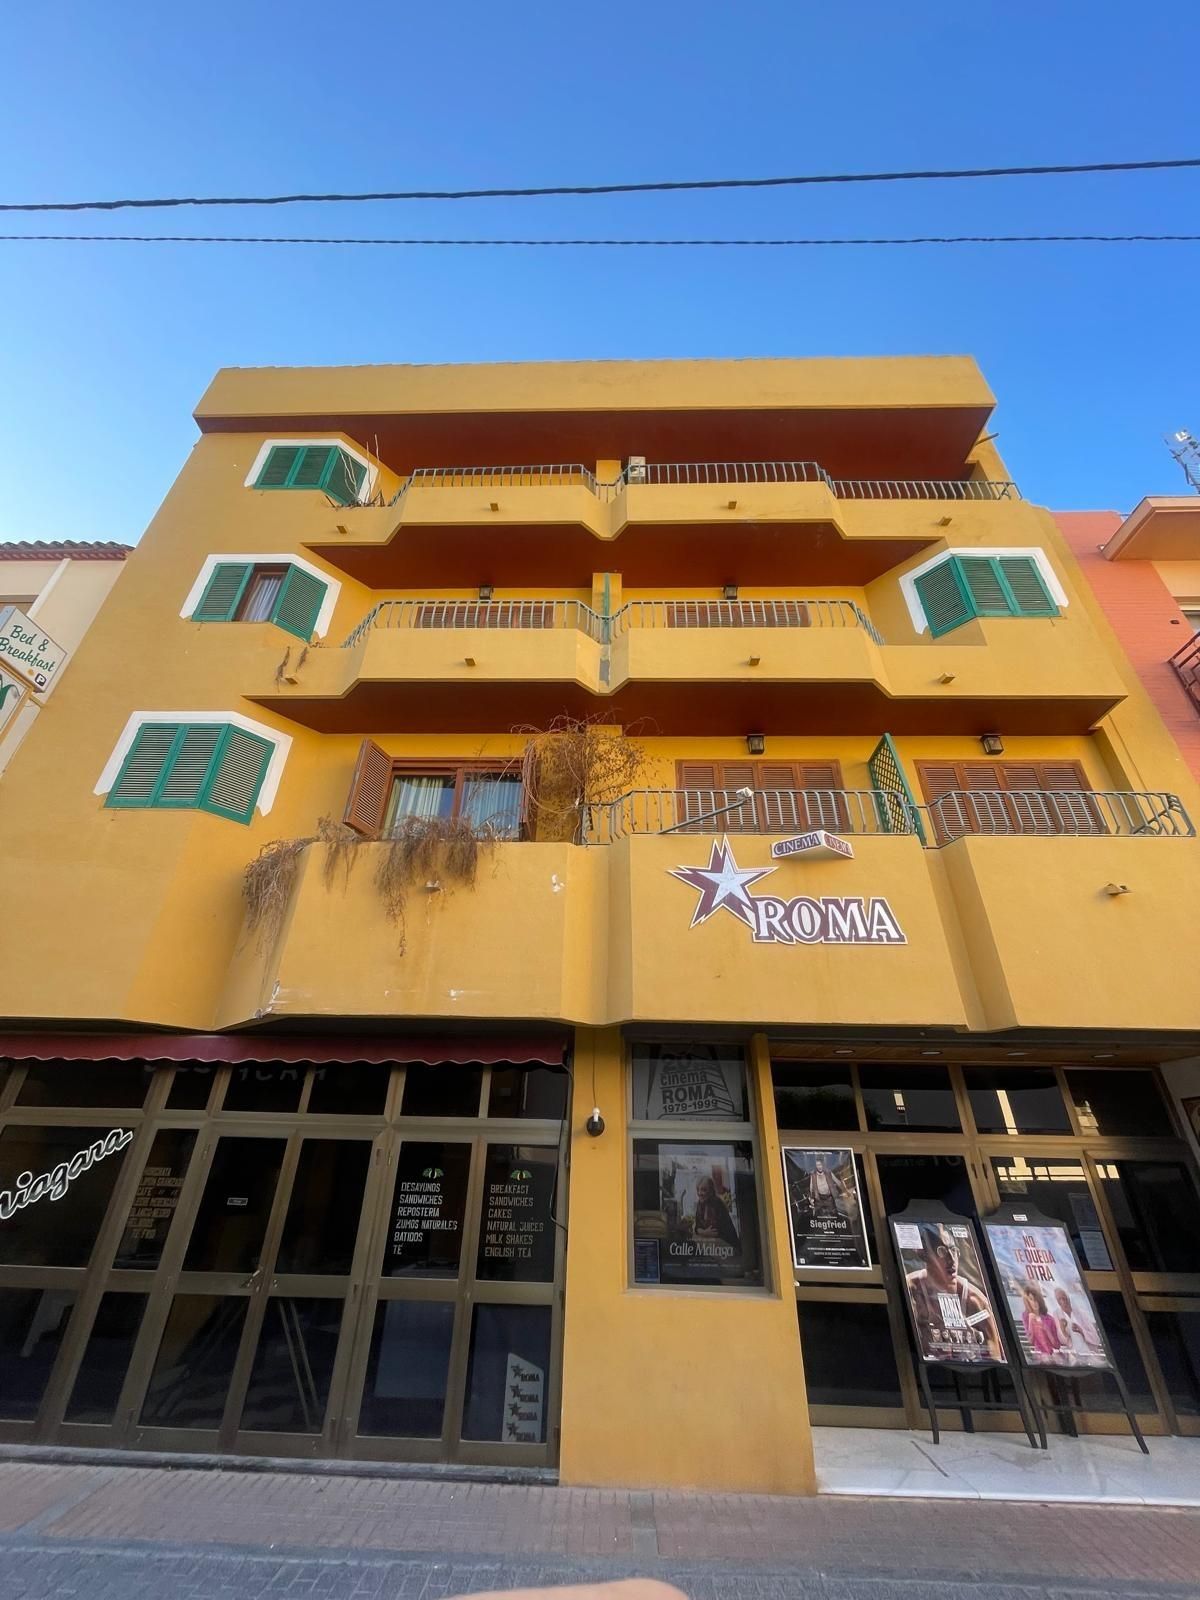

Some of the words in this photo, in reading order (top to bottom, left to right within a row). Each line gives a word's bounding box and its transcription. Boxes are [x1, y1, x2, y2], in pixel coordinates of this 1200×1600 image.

[10, 625, 37, 645] Bed
[38, 639, 49, 652] &
[0, 637, 55, 672] Breakfast
[774, 833, 821, 855] CINEMA
[754, 897, 907, 943] ROMA
[660, 1071, 707, 1086] cinema
[662, 1085, 714, 1104] ROMA
[400, 1182, 441, 1193] DESAYUNOS
[490, 1184, 529, 1194] BREAKFAST
[399, 1194, 443, 1205] SANDWICHES
[489, 1196, 534, 1207] SANDWICHES
[488, 1208, 512, 1219] CAKES
[395, 1218, 420, 1229] ZUMOS
[421, 1219, 458, 1231] NATURALES
[487, 1220, 516, 1231] NATURAL
[519, 1221, 544, 1232] JUICES
[810, 1219, 847, 1230] Siegfried
[393, 1231, 423, 1242] BATIDOS
[485, 1234, 504, 1244] MILK
[505, 1234, 533, 1245] SHAKES
[1022, 1235, 1037, 1248] NO
[484, 1247, 514, 1257] ENGLISH
[517, 1247, 532, 1258] TEA
[669, 1241, 694, 1256] Calle
[1026, 1265, 1055, 1281] OTRA
